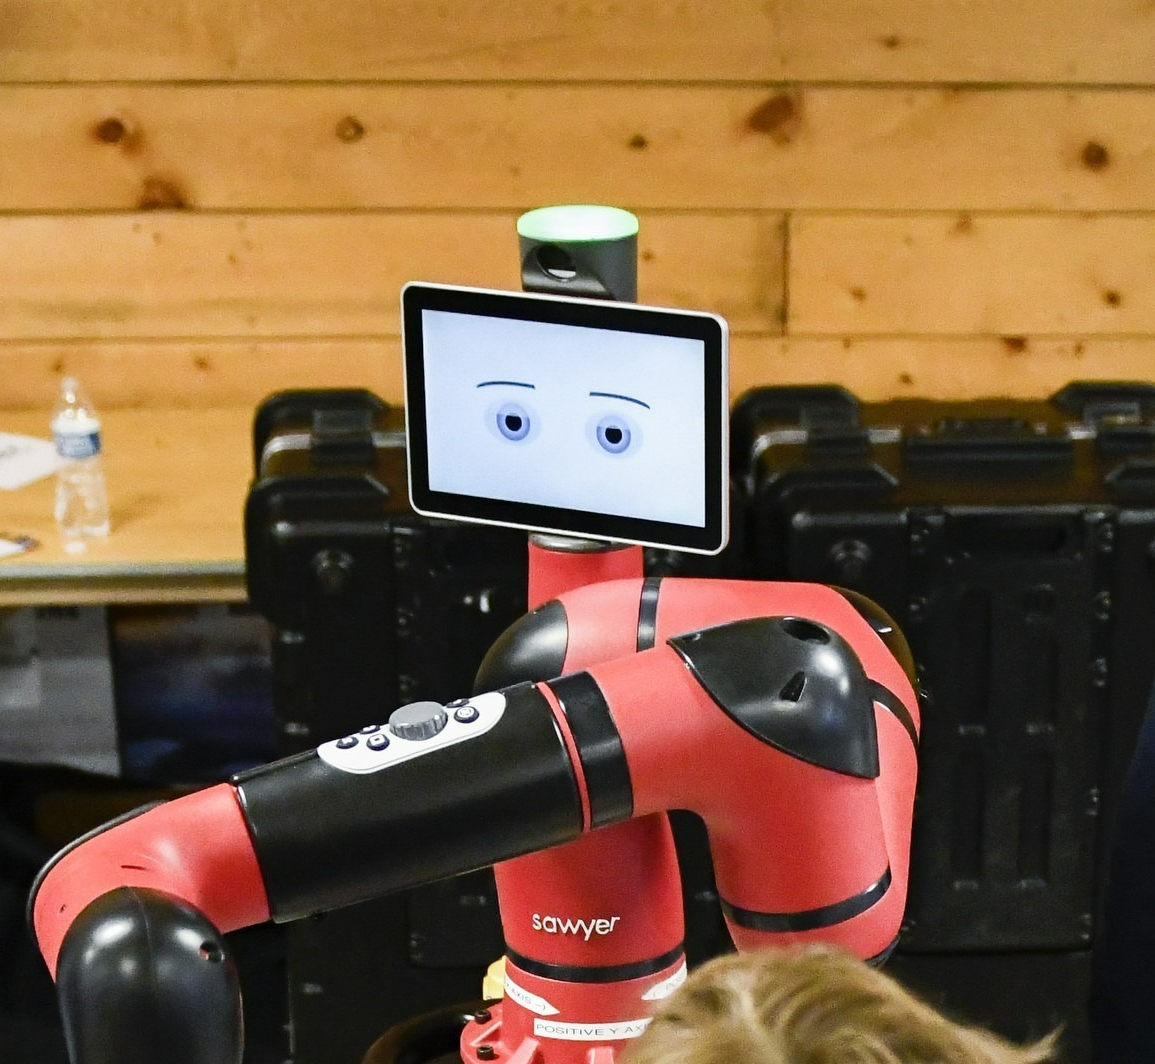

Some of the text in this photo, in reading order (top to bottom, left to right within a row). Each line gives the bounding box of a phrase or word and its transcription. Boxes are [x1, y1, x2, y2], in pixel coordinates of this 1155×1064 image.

[532, 913, 621, 941] sawyer
[536, 1023, 605, 1037] POSITIVE
[610, 1024, 620, 1036] Y
